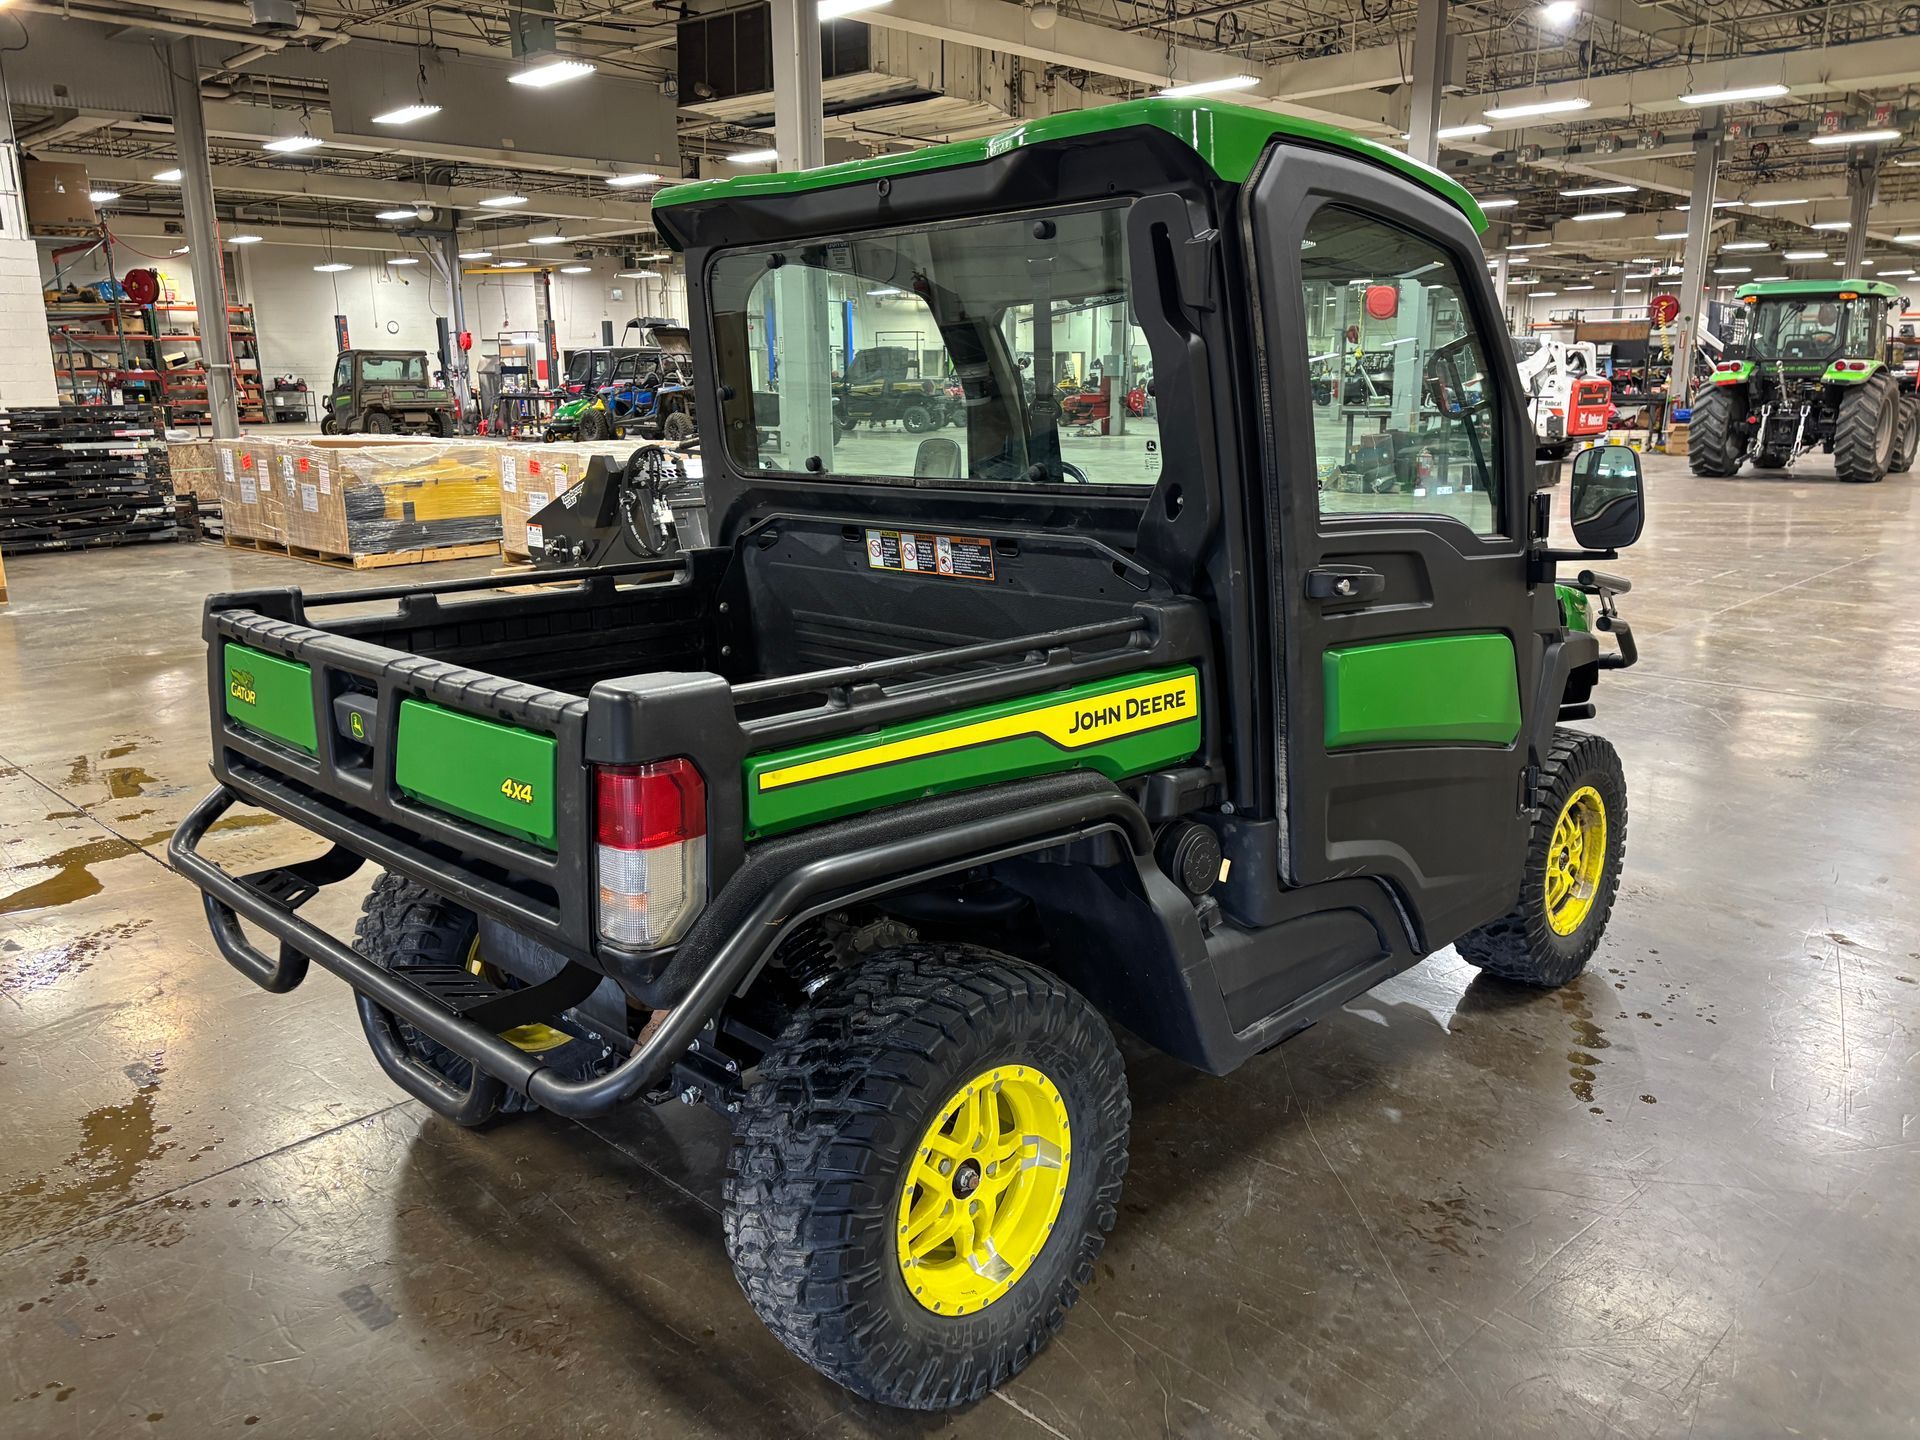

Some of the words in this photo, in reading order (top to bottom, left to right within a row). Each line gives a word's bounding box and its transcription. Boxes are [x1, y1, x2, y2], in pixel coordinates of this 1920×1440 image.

[1823, 116, 1839, 127] 103
[1729, 126, 1741, 136] 99
[1600, 139, 1610, 149] 93
[1641, 136, 1653, 146] 95
[1587, 413, 1604, 426] Bobcat
[230, 681, 256, 705] GATOR
[1069, 705, 1121, 734] JOHN
[1126, 690, 1186, 720] DEERE
